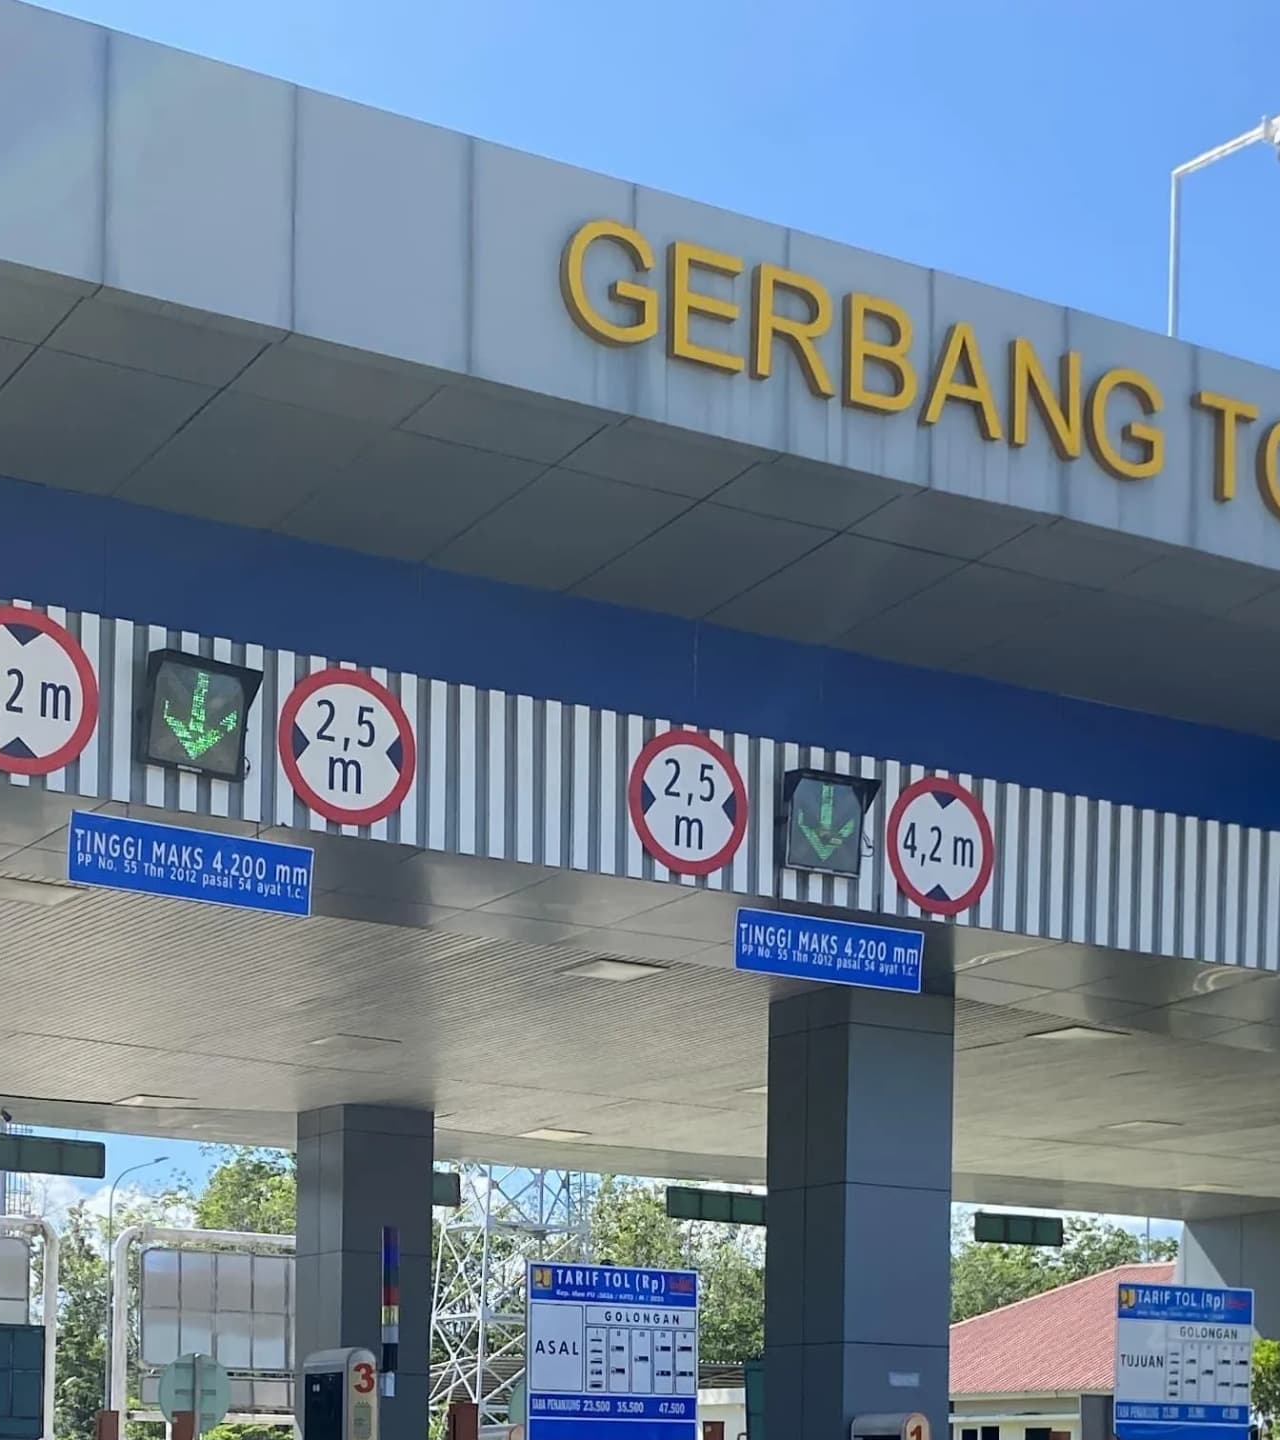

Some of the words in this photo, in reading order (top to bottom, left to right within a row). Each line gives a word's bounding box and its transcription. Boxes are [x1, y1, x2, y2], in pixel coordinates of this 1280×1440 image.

[559, 219, 1165, 480] GERBANG
[40, 680, 72, 722] m
[317, 700, 376, 752] 2,5
[328, 757, 362, 795] m
[664, 758, 715, 806] 2,5
[674, 814, 704, 850] m
[904, 821, 942, 866] 4,2
[953, 835, 974, 868] m
[75, 829, 142, 860] TINGGI
[152, 841, 203, 870] MAKS
[212, 851, 266, 879] 4.200
[276, 865, 307, 885] mm
[78, 853, 91, 865] PP
[98, 857, 117, 872] No.
[124, 860, 137, 873] 55
[144, 864, 163, 878] Thn
[170, 868, 196, 883] 2012
[203, 872, 233, 888] pasal
[239, 878, 251, 891] 54
[257, 881, 280, 897] ayat
[740, 923, 791, 948] TINGGI
[799, 931, 837, 955] MAKS
[845, 938, 886, 961] 4.200
[893, 947, 918, 964] mm
[742, 944, 752, 955] PP
[792, 950, 808, 962] Thn
[812, 954, 832, 967] 2012
[837, 956, 860, 971] pasal
[879, 961, 898, 976] ayat
[557, 1269, 599, 1286] TARIF
[604, 1272, 630, 1288] TOL
[636, 1273, 665, 1294] (Rp)
[1137, 1289, 1170, 1303] TARIF
[1175, 1291, 1196, 1307] TOL
[605, 1311, 679, 1325] GOLONGAN
[1180, 1326, 1238, 1340] GOLONGAN
[535, 1340, 578, 1355] ASAL
[1121, 1354, 1164, 1368] TUJUAN
[353, 1363, 375, 1393] 3
